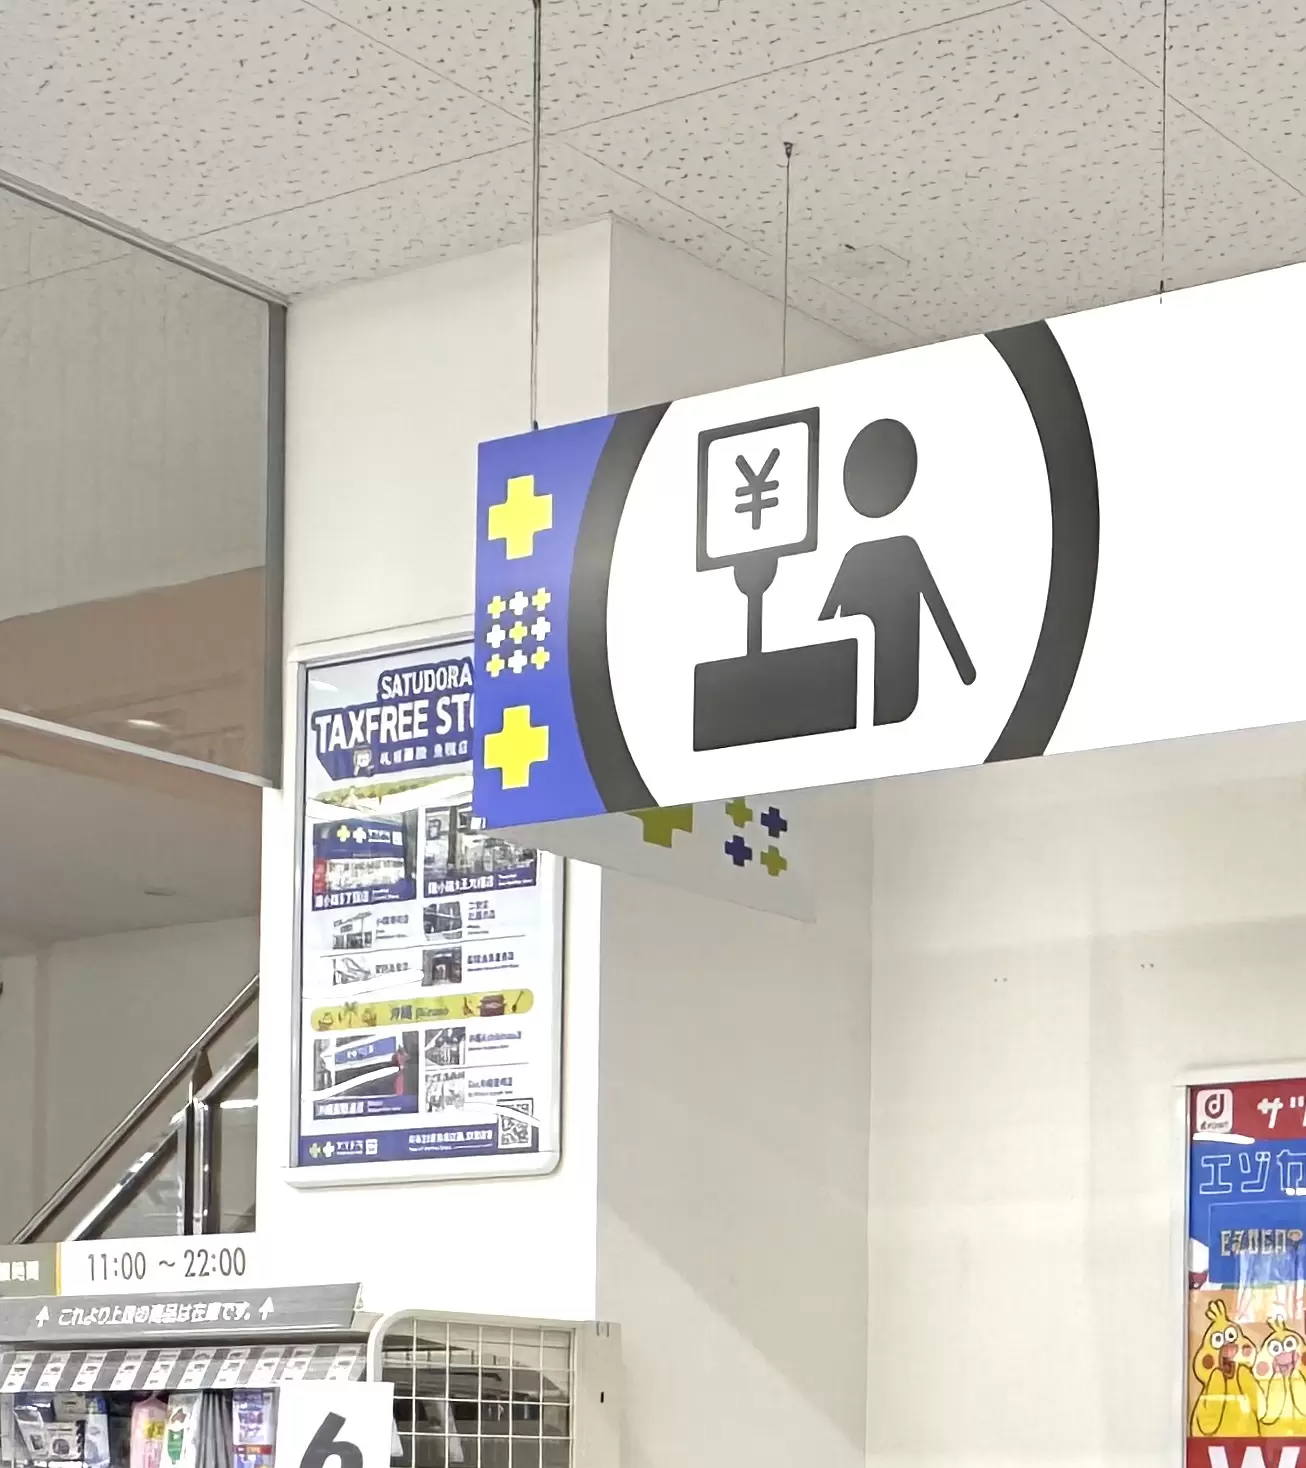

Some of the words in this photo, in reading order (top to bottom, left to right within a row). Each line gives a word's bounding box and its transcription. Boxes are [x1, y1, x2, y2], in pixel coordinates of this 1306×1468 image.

[381, 663, 473, 698] SATUDORA
[315, 700, 428, 753] TAXFREE
[88, 1251, 146, 1281] 11:00
[184, 1248, 246, 1277] 22:00
